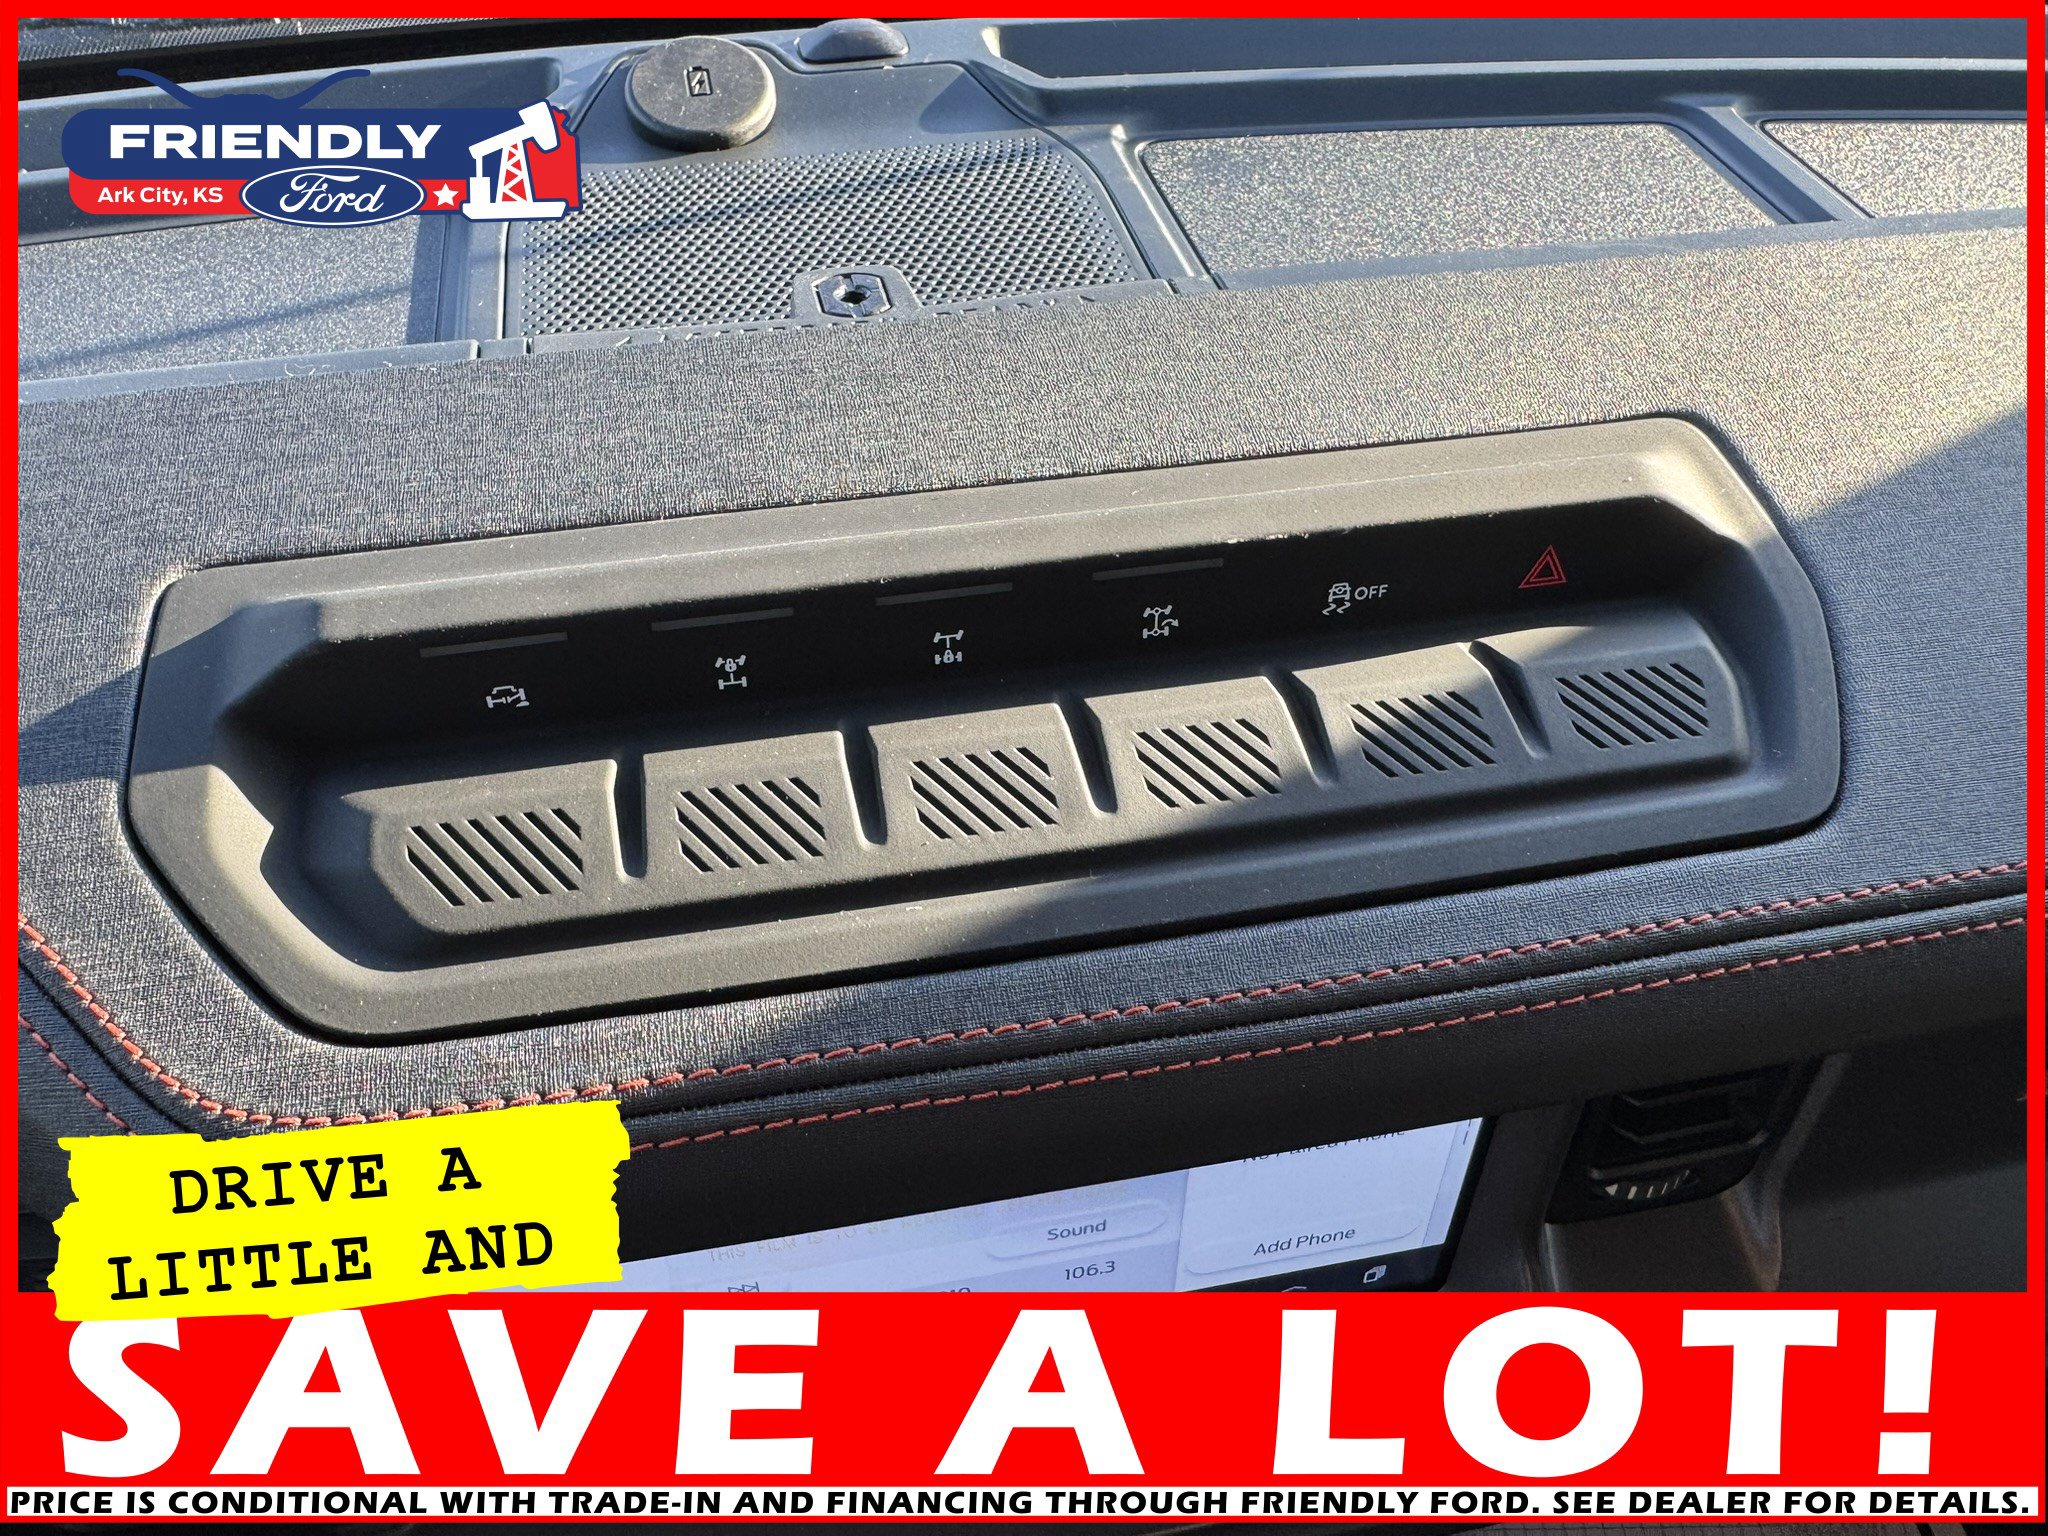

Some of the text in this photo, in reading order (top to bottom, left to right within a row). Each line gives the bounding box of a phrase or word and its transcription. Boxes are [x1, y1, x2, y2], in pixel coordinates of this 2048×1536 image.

[1354, 584, 1389, 601] OFF
[1047, 1219, 1107, 1241] Sound
[1253, 1229, 1356, 1256] Add Phone
[1065, 1260, 1116, 1281] 106.3
